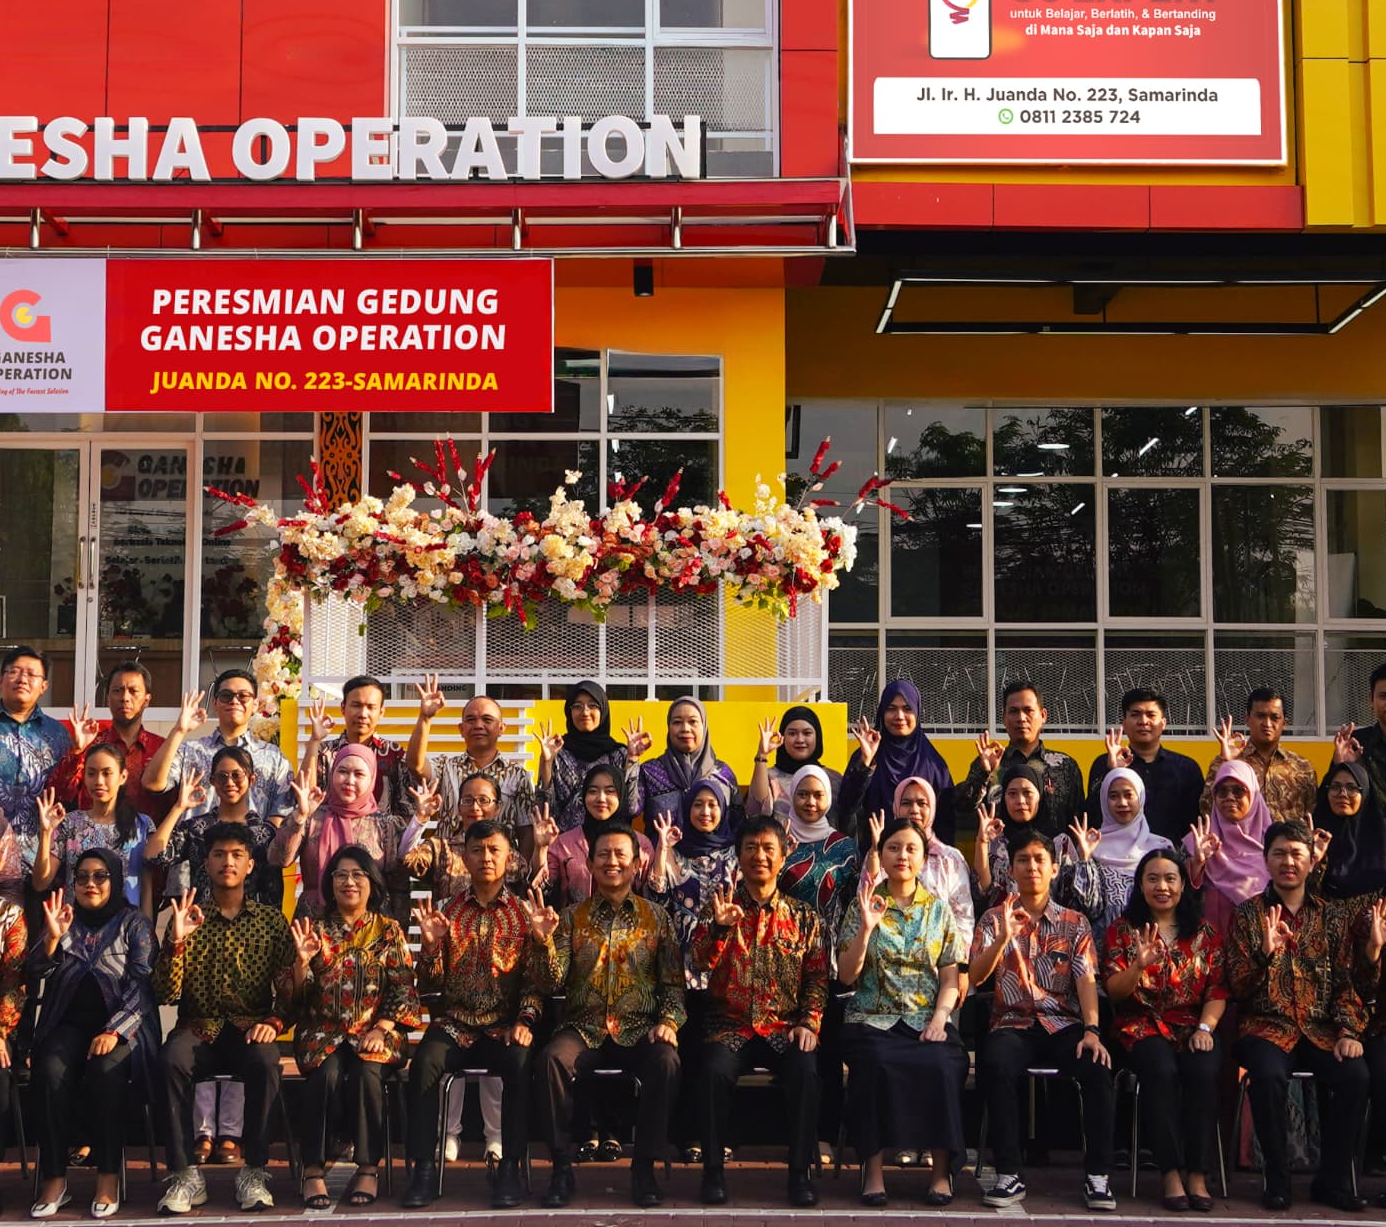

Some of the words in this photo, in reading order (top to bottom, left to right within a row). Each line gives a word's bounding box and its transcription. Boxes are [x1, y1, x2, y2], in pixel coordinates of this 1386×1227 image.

[1010, 8, 1043, 19] untuk
[1045, 8, 1088, 21] Belajar,
[1090, 8, 1139, 20] Berlatih,
[1142, 9, 1151, 19] &
[1153, 8, 1216, 21] Bertanding
[1025, 24, 1037, 36] di
[1040, 25, 1073, 36] Mana
[1077, 24, 1103, 38] Saja
[1105, 24, 1129, 36] dan
[1132, 25, 1171, 38] Kapan
[1174, 24, 1201, 38] Saja
[917, 87, 936, 101] Jl.
[941, 87, 958, 101] Ir.
[963, 87, 981, 101] H.
[986, 87, 1047, 102] Juanda
[1053, 88, 1081, 102] No.
[1086, 88, 1123, 104] 223,
[1128, 87, 1219, 102] Samarinda
[1019, 110, 1056, 123] 0811
[1061, 110, 1106, 124] 2385
[1109, 110, 1141, 124] 724
[232, 113, 703, 181] OPERATION
[151, 288, 345, 315] PERESMIAN
[356, 288, 499, 315] GEDUNG
[140, 324, 303, 352] GANESHA
[312, 323, 506, 351] OPERATION
[150, 371, 247, 394] JUANDA
[254, 371, 297, 391] NO.
[303, 371, 499, 391] 223-SAMARINDA
